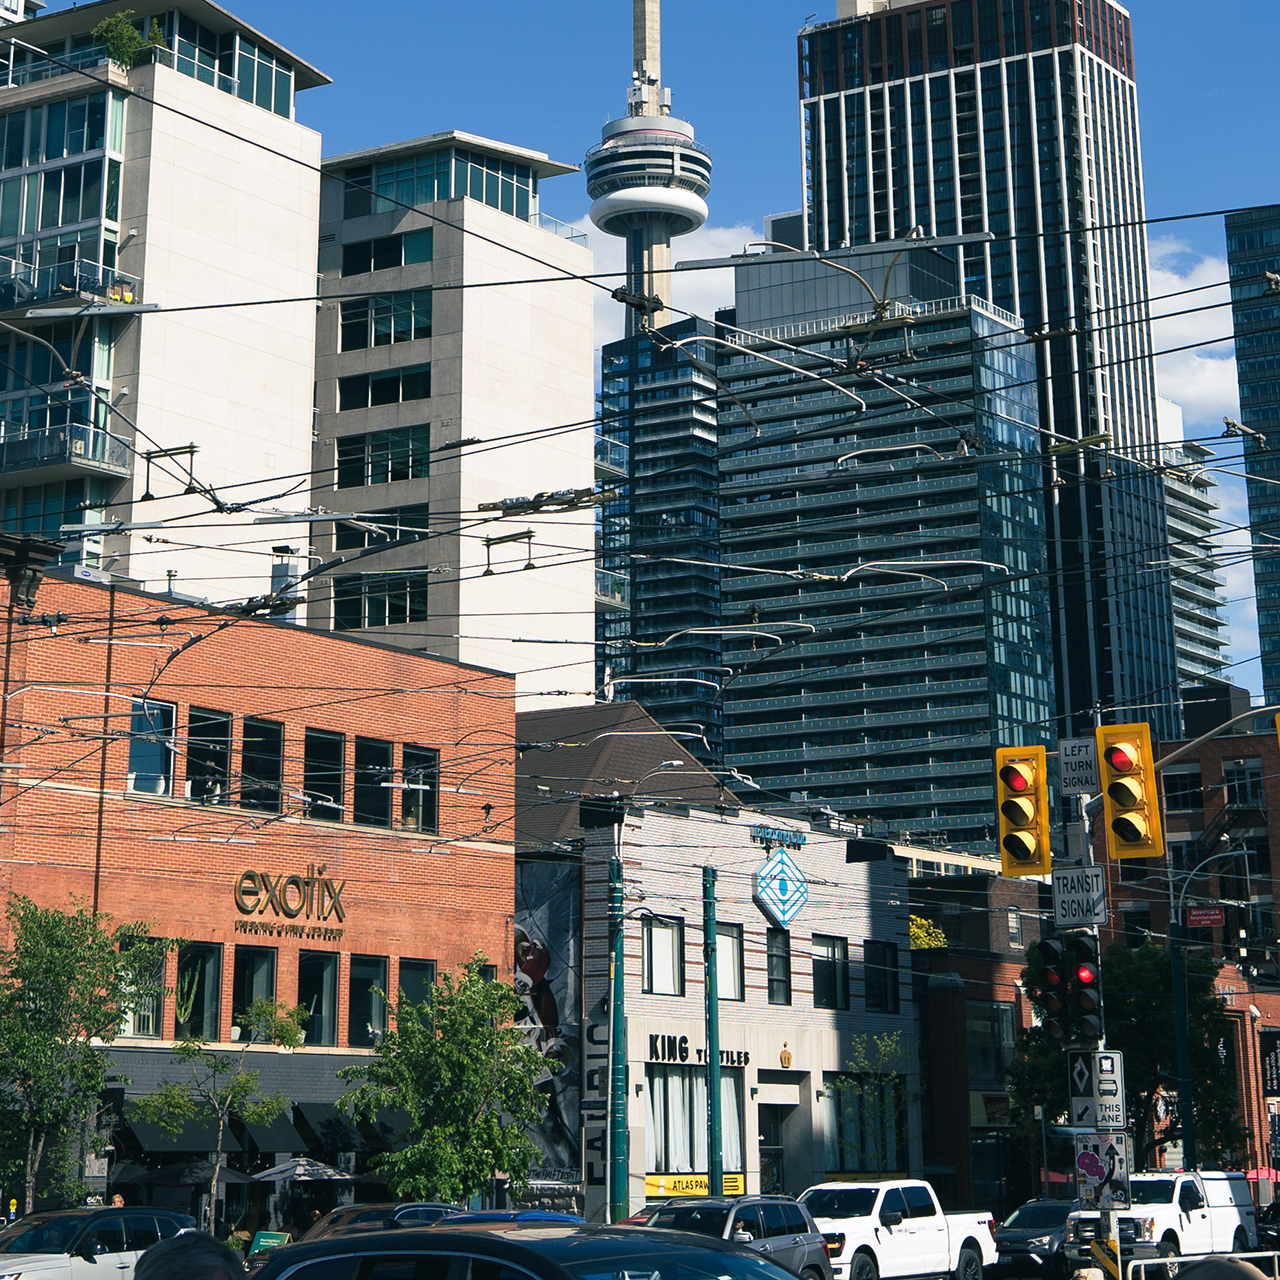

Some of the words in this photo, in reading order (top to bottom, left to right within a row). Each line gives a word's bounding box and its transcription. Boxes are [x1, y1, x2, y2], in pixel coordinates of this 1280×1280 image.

[1064, 744, 1090, 757] LEFT
[1063, 760, 1093, 772] TURN
[1062, 776, 1096, 788] SIGNAL
[1055, 873, 1100, 894] TRANSIT
[234, 863, 347, 923] exotix
[1060, 898, 1100, 918] SIGNAL
[649, 1034, 689, 1063] KING
[696, 1049, 750, 1066] TTILES
[1099, 1104, 1121, 1112] THIS
[1095, 1114, 1121, 1123] LANE
[672, 1180, 694, 1191] ATLAS
[695, 1180, 709, 1190] PAW
